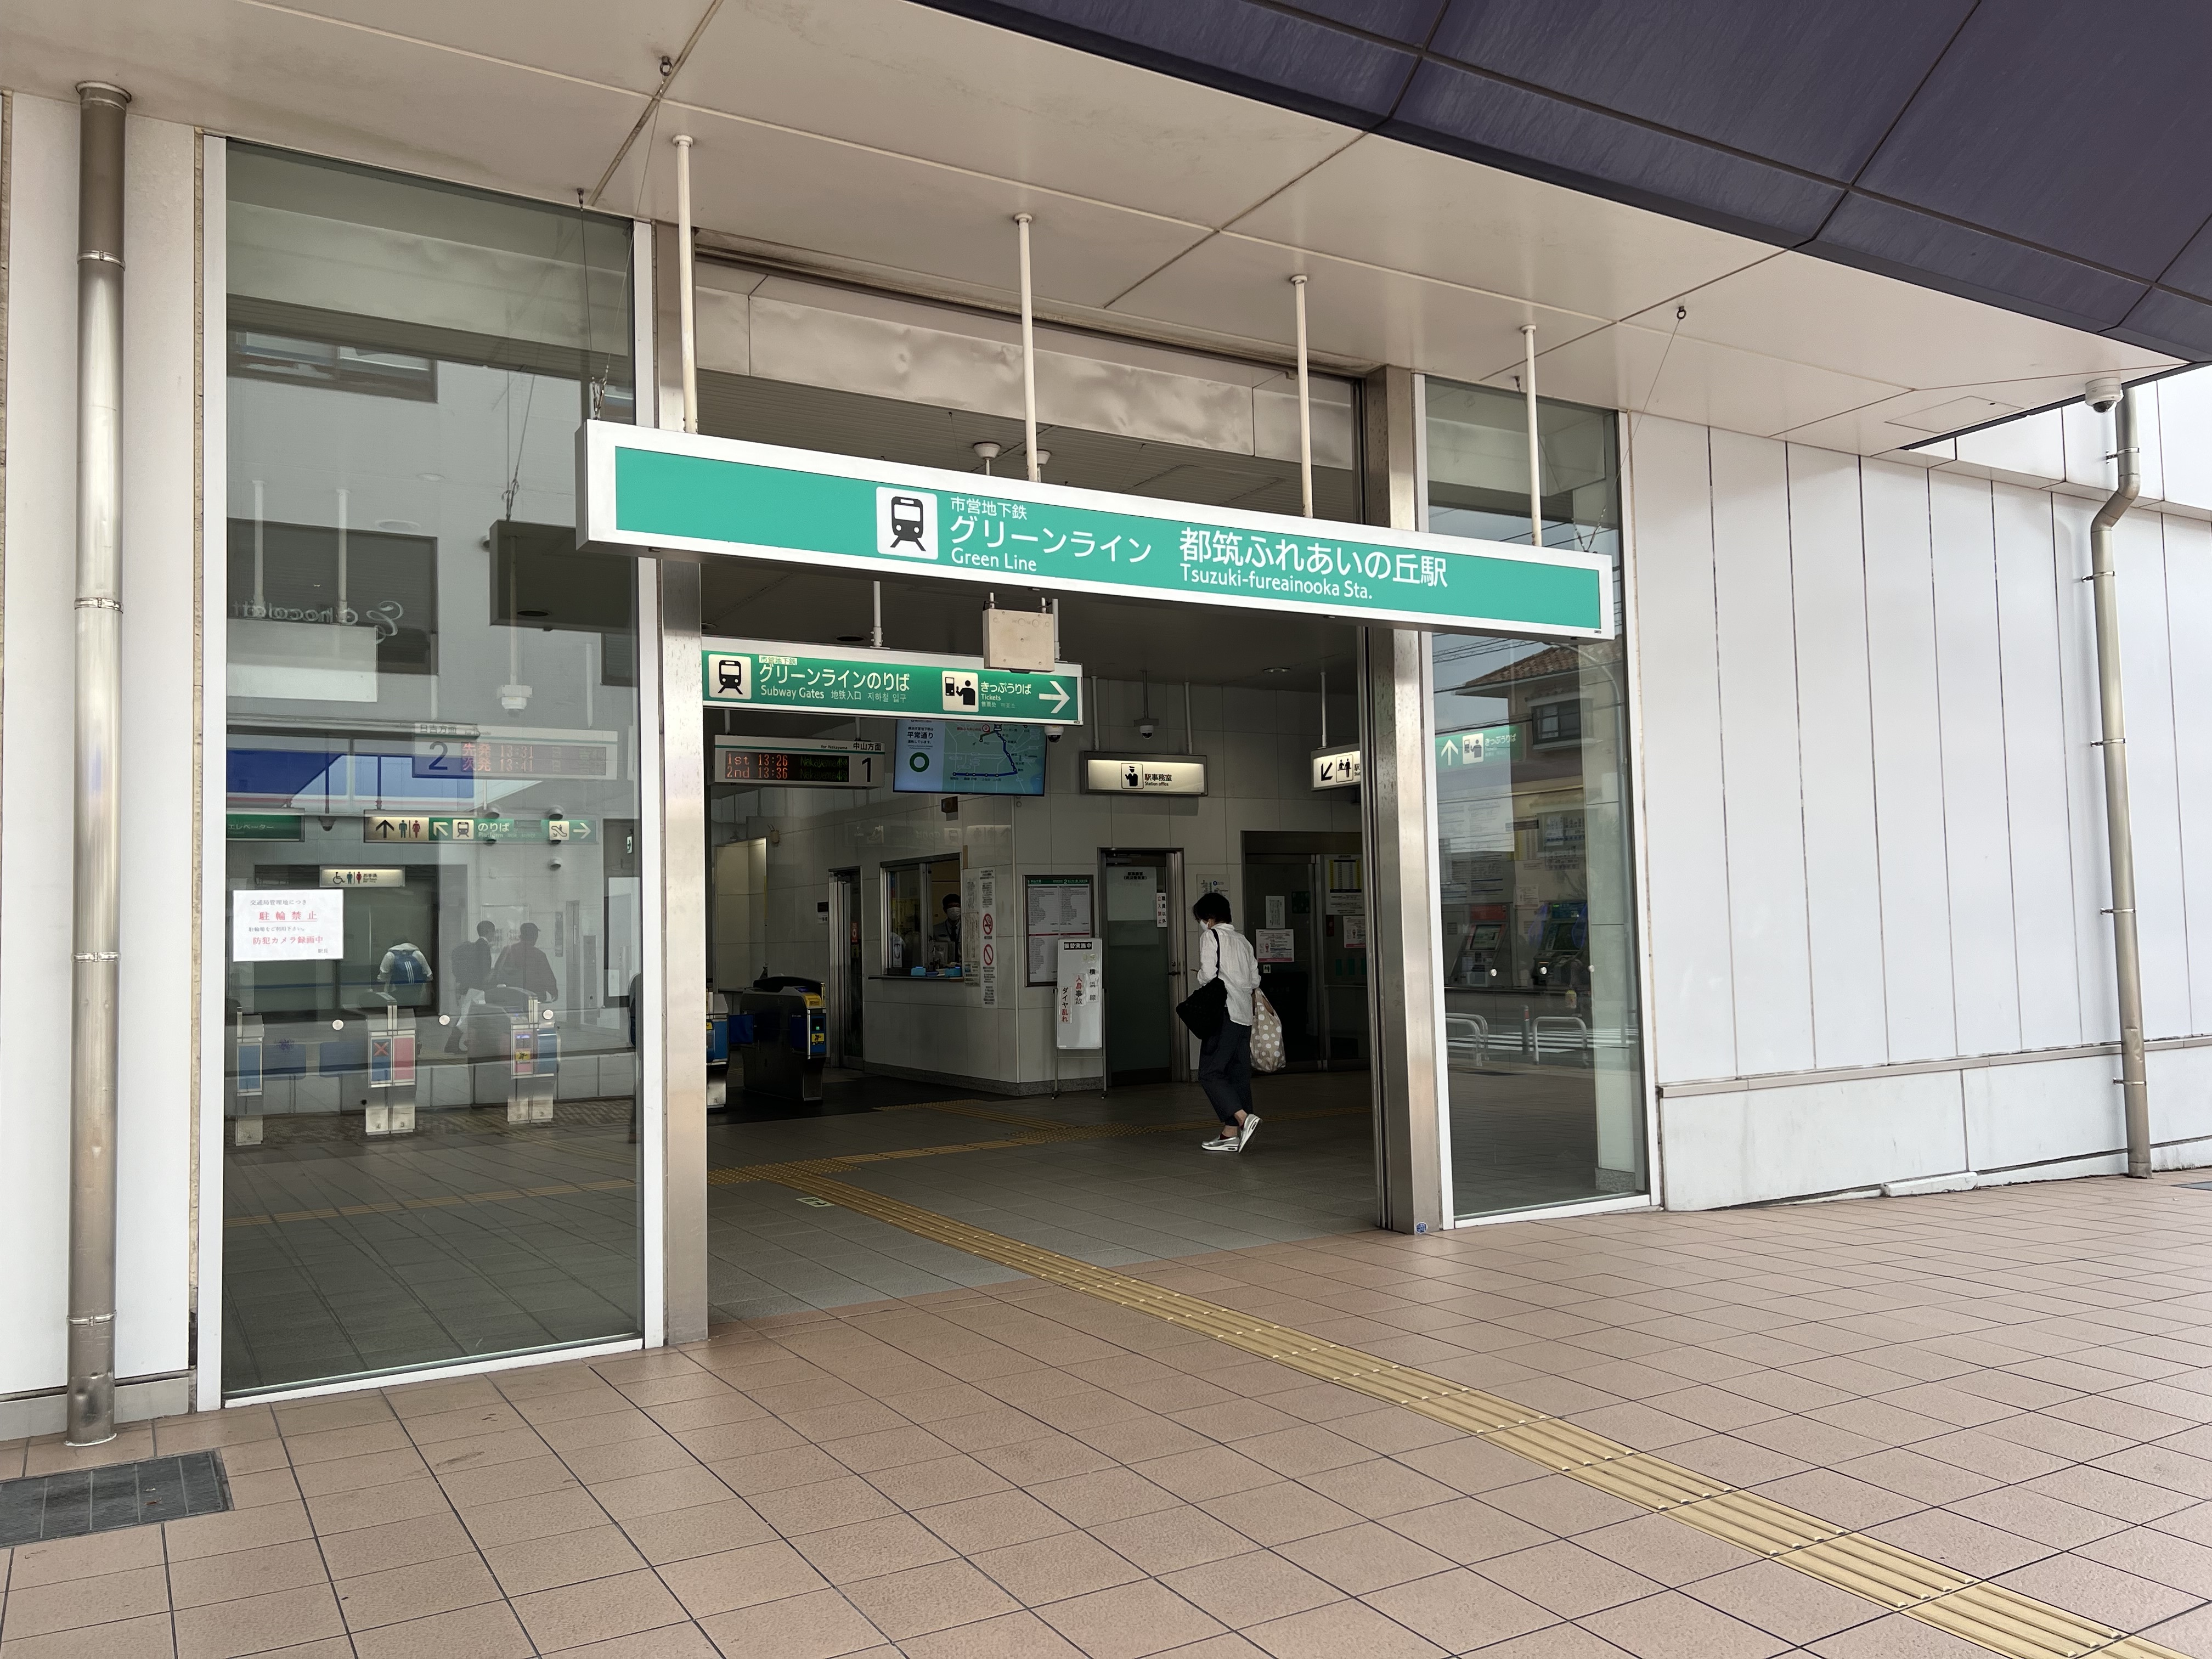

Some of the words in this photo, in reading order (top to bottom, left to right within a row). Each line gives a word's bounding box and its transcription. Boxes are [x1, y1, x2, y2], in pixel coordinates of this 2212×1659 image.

[950, 496, 1028, 521] 市営地下鉄
[950, 515, 1152, 563] グリーンライン
[951, 547, 1000, 568] Green
[1004, 552, 1037, 572] Line
[1179, 526, 1449, 589] 都筑ふれあいの丘駅
[1180, 563, 1340, 597] Tsuzuki-fureainooka
[1344, 579, 1373, 600] Sta.
[760, 656, 797, 665] 市営地下鉄
[759, 663, 911, 692] グリーンラインのりば
[760, 685, 797, 700] Subway
[798, 687, 825, 699] Gates
[980, 681, 1032, 695] きっぷうりば
[831, 690, 862, 701] 地铁入口
[867, 692, 889, 702] 지하철
[892, 693, 907, 703] 입구
[419, 724, 457, 734] 日吉方面
[907, 731, 934, 740] 平常通り
[1485, 733, 1517, 746] きっぷうりば
[462, 743, 491, 757] 先発
[853, 742, 882, 752] 中山方面
[428, 741, 448, 771] 2
[727, 753, 749, 765] 1st
[758, 754, 788, 767] 13:26
[462, 758, 491, 772] 次発
[862, 757, 872, 782] 1
[727, 766, 750, 778] 2nd
[758, 767, 788, 780] 13:36
[1144, 774, 1172, 782] 駅事務室
[478, 822, 510, 832] のりば
[252, 935, 324, 945] 防犯カメラ録画中
